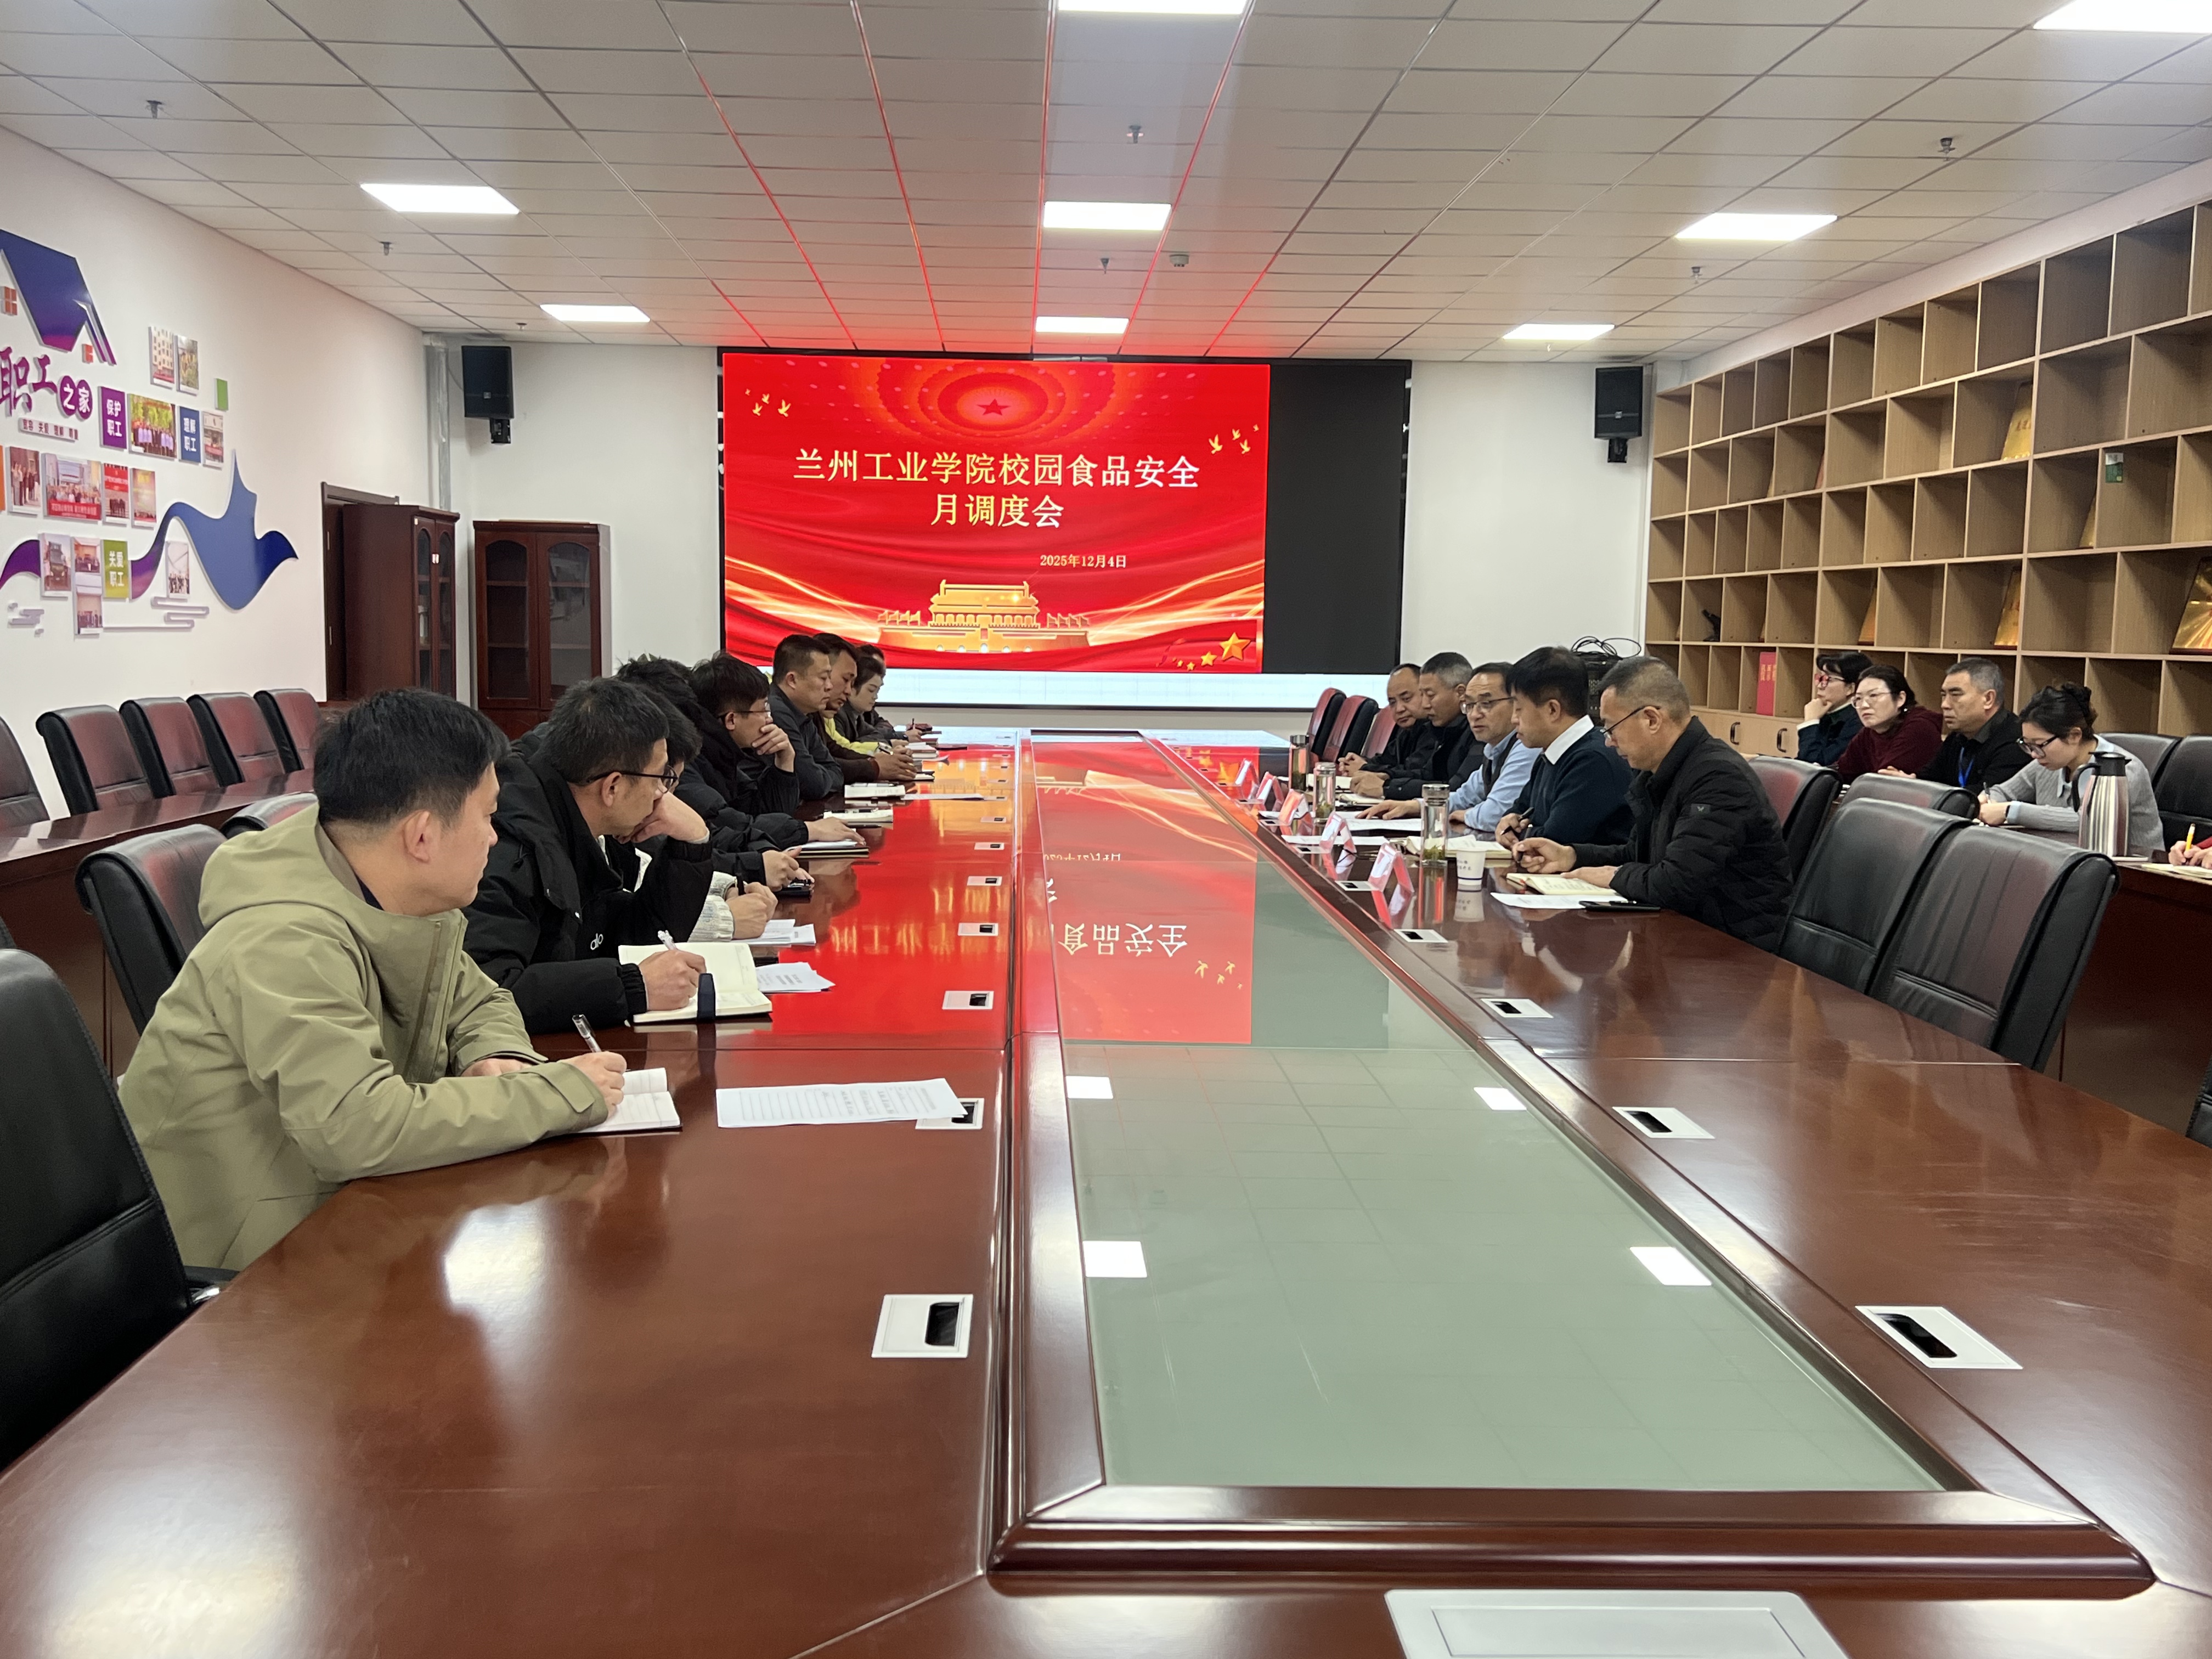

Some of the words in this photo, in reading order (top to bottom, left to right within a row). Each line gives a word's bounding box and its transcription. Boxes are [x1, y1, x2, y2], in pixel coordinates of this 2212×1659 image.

[107, 419, 123, 437] 职工
[793, 448, 1200, 489] 兰州工业学院校园食品安全
[930, 494, 1065, 530] 月调度会
[1040, 554, 1127, 569] 2025年12月4日
[109, 571, 125, 588] 职工
